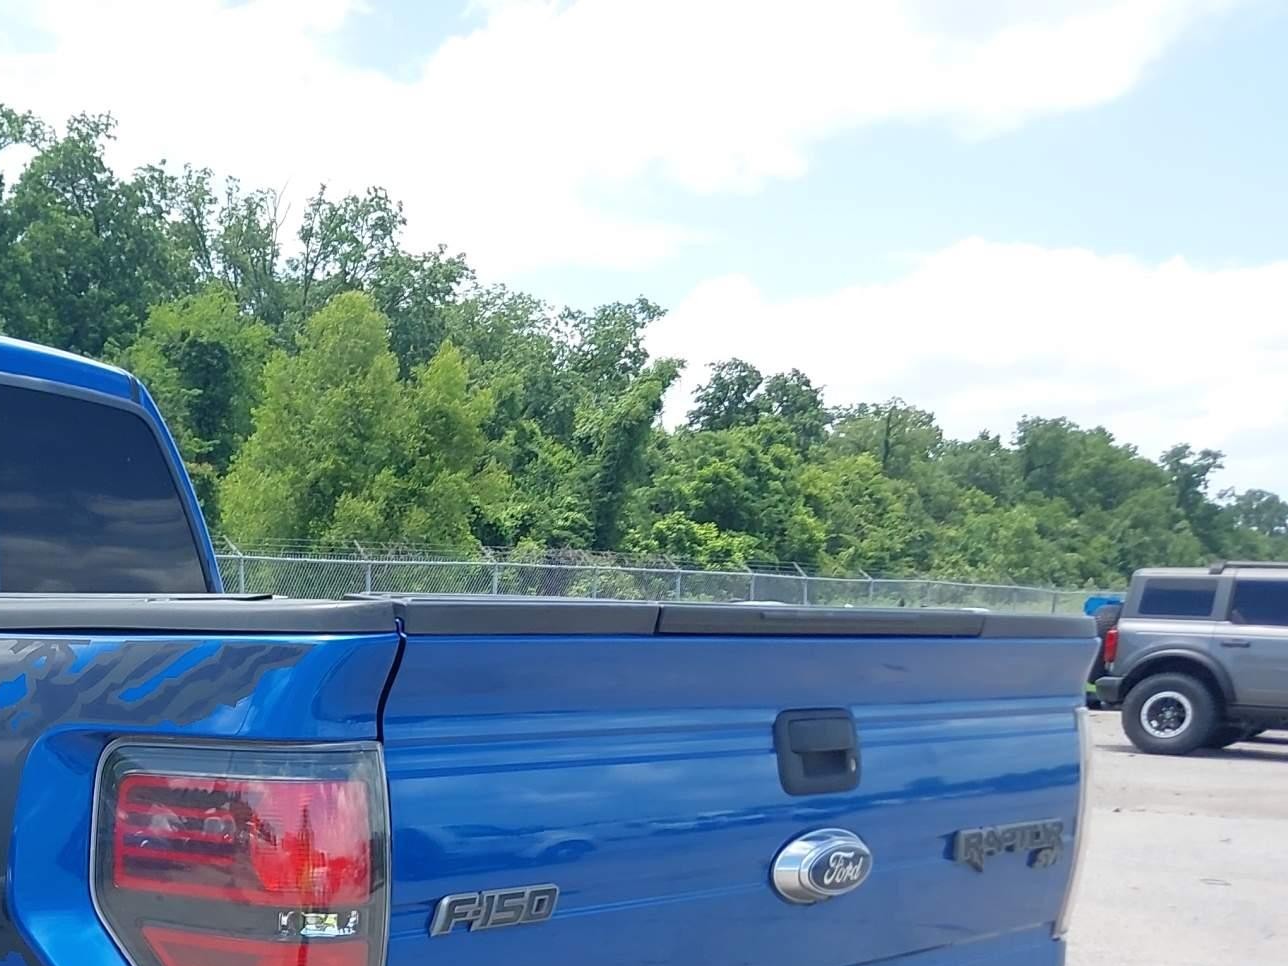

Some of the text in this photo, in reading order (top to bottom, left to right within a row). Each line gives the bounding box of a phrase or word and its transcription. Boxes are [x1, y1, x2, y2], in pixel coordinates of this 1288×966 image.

[823, 851, 864, 886] Ford
[955, 817, 1064, 873] RAPTOR
[431, 882, 560, 937] F-150
